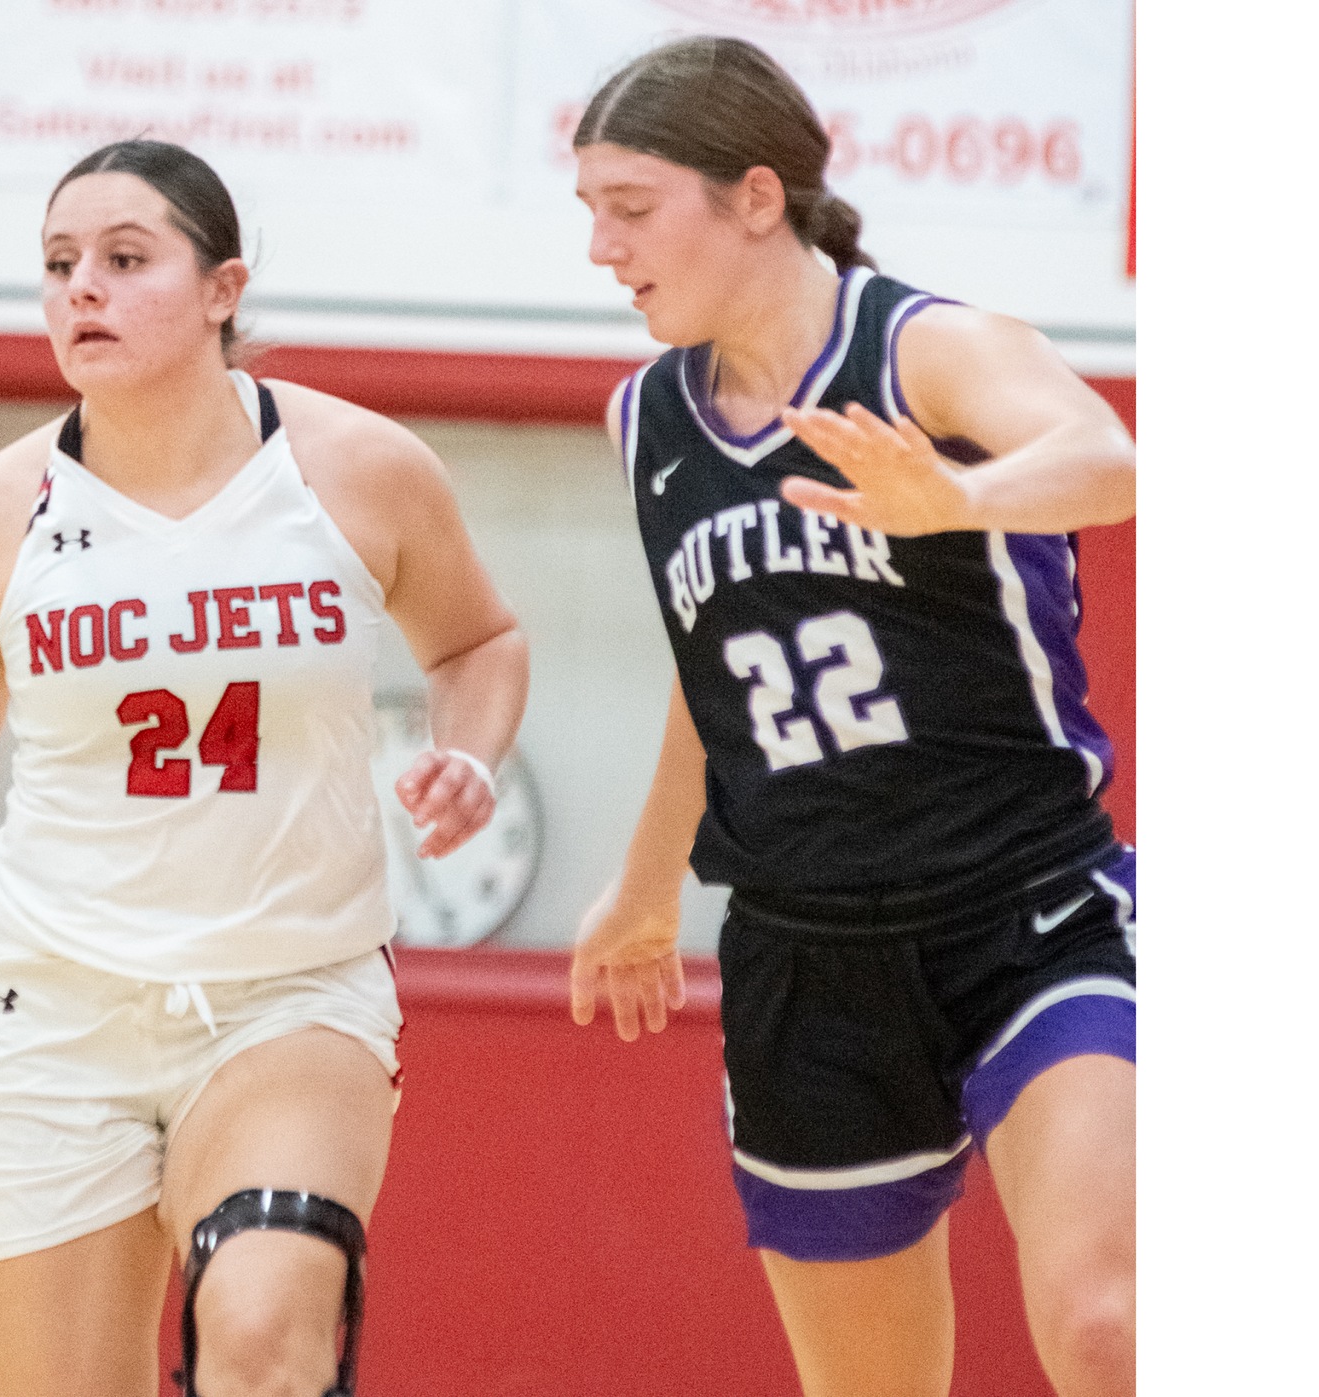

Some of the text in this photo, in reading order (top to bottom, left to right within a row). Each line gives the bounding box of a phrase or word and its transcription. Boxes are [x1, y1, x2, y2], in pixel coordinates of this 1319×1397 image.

[25, 579, 347, 676] NOC JETS
[666, 499, 905, 633] BUTLER
[115, 680, 261, 798] 24
[724, 609, 910, 772] 22
